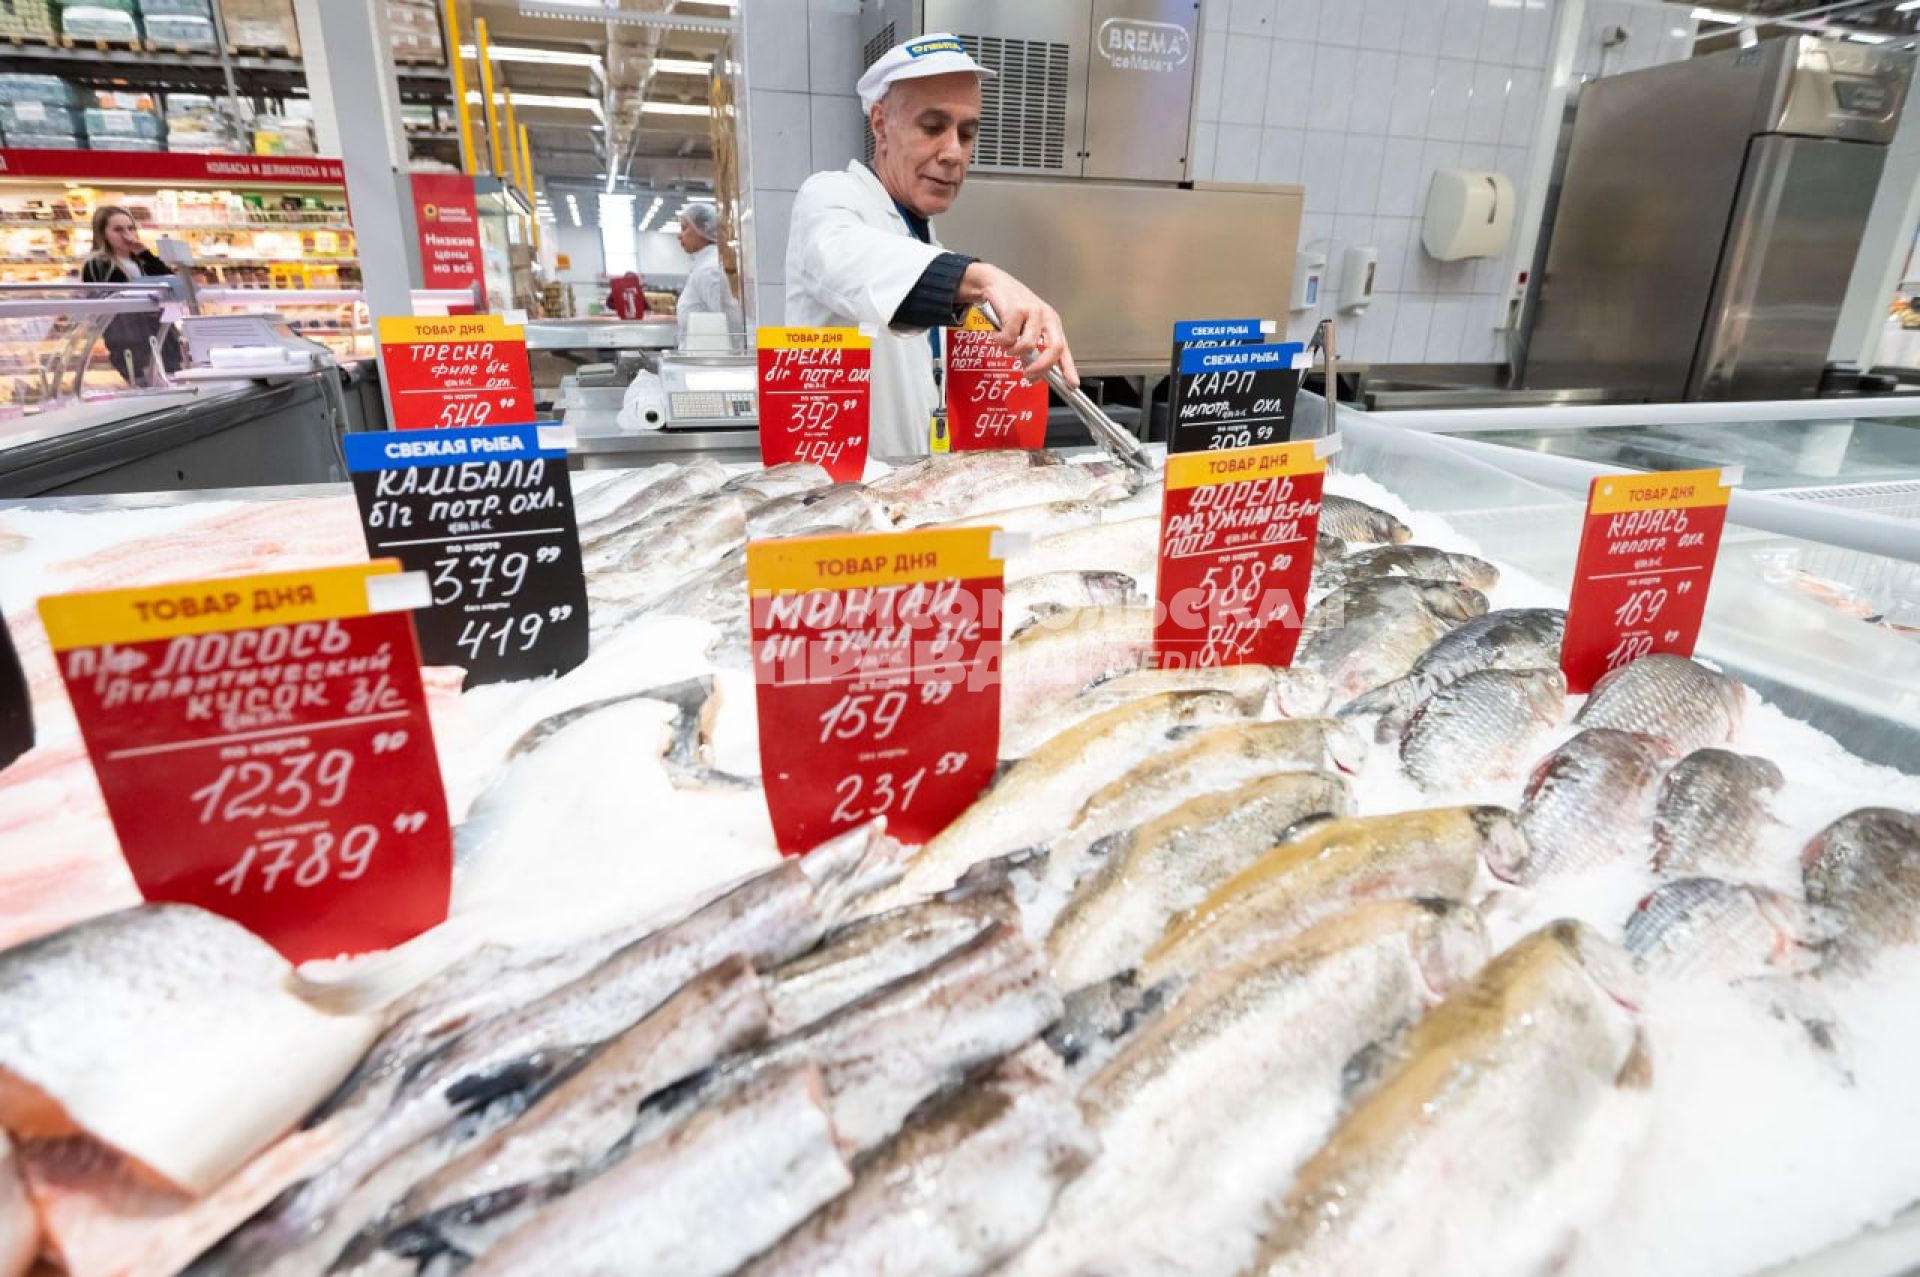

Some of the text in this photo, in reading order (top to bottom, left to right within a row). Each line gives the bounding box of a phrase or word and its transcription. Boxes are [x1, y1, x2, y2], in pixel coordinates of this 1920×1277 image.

[1110, 28, 1181, 55] BREMA
[206, 162, 250, 174] КОЛБАСЫ
[252, 164, 260, 174] И
[261, 164, 319, 177] ДЕЛИКАТЕСЫ
[425, 232, 474, 247] Низкие
[433, 262, 474, 273] на всё
[435, 250, 468, 261] цены
[416, 325, 484, 336] ТОВАР ДНЯ
[786, 334, 843, 343] ТОВАР ДНЯ
[954, 330, 997, 344] ФОРЕ
[1192, 326, 1248, 335] СВЕЖАЯ РЫБА
[409, 344, 494, 361] ТРЕСКА
[774, 348, 842, 365] ТРЕСКА
[1203, 352, 1279, 366] СВЕЖАЯ РЫБА
[972, 380, 1017, 402] 567
[1188, 370, 1256, 398] КАРП
[434, 402, 491, 429] 549
[787, 402, 838, 432] 392
[975, 414, 1017, 438] 947
[385, 436, 524, 458] СВЕЖАЯ РЫБА
[1208, 426, 1273, 450] 309 99
[795, 440, 844, 465] 494
[1209, 453, 1288, 474] ТОВАР ДНЯ
[376, 458, 545, 497] КАМБАЛА
[1188, 475, 1293, 512] ФОРЕЛЬ
[1629, 486, 1695, 502] ТОВАР ДНЯ
[1607, 508, 1688, 538] КАРАСЬ
[433, 546, 561, 605] 379 99
[816, 552, 937, 576] ТОВАР ДНЯ
[1191, 561, 1265, 610] 588
[133, 584, 316, 622] ТОВАР ДНЯ
[766, 576, 960, 630] МИНТАЙ
[1614, 588, 1668, 627] 169
[457, 604, 572, 659] 419 99
[1200, 618, 1260, 668] 842
[152, 619, 350, 680] ЛОСОСЬ
[1606, 636, 1653, 670] 189
[819, 691, 907, 743] 159
[190, 748, 354, 823] 1239
[831, 767, 926, 823] 231
[214, 824, 380, 895] 1789
